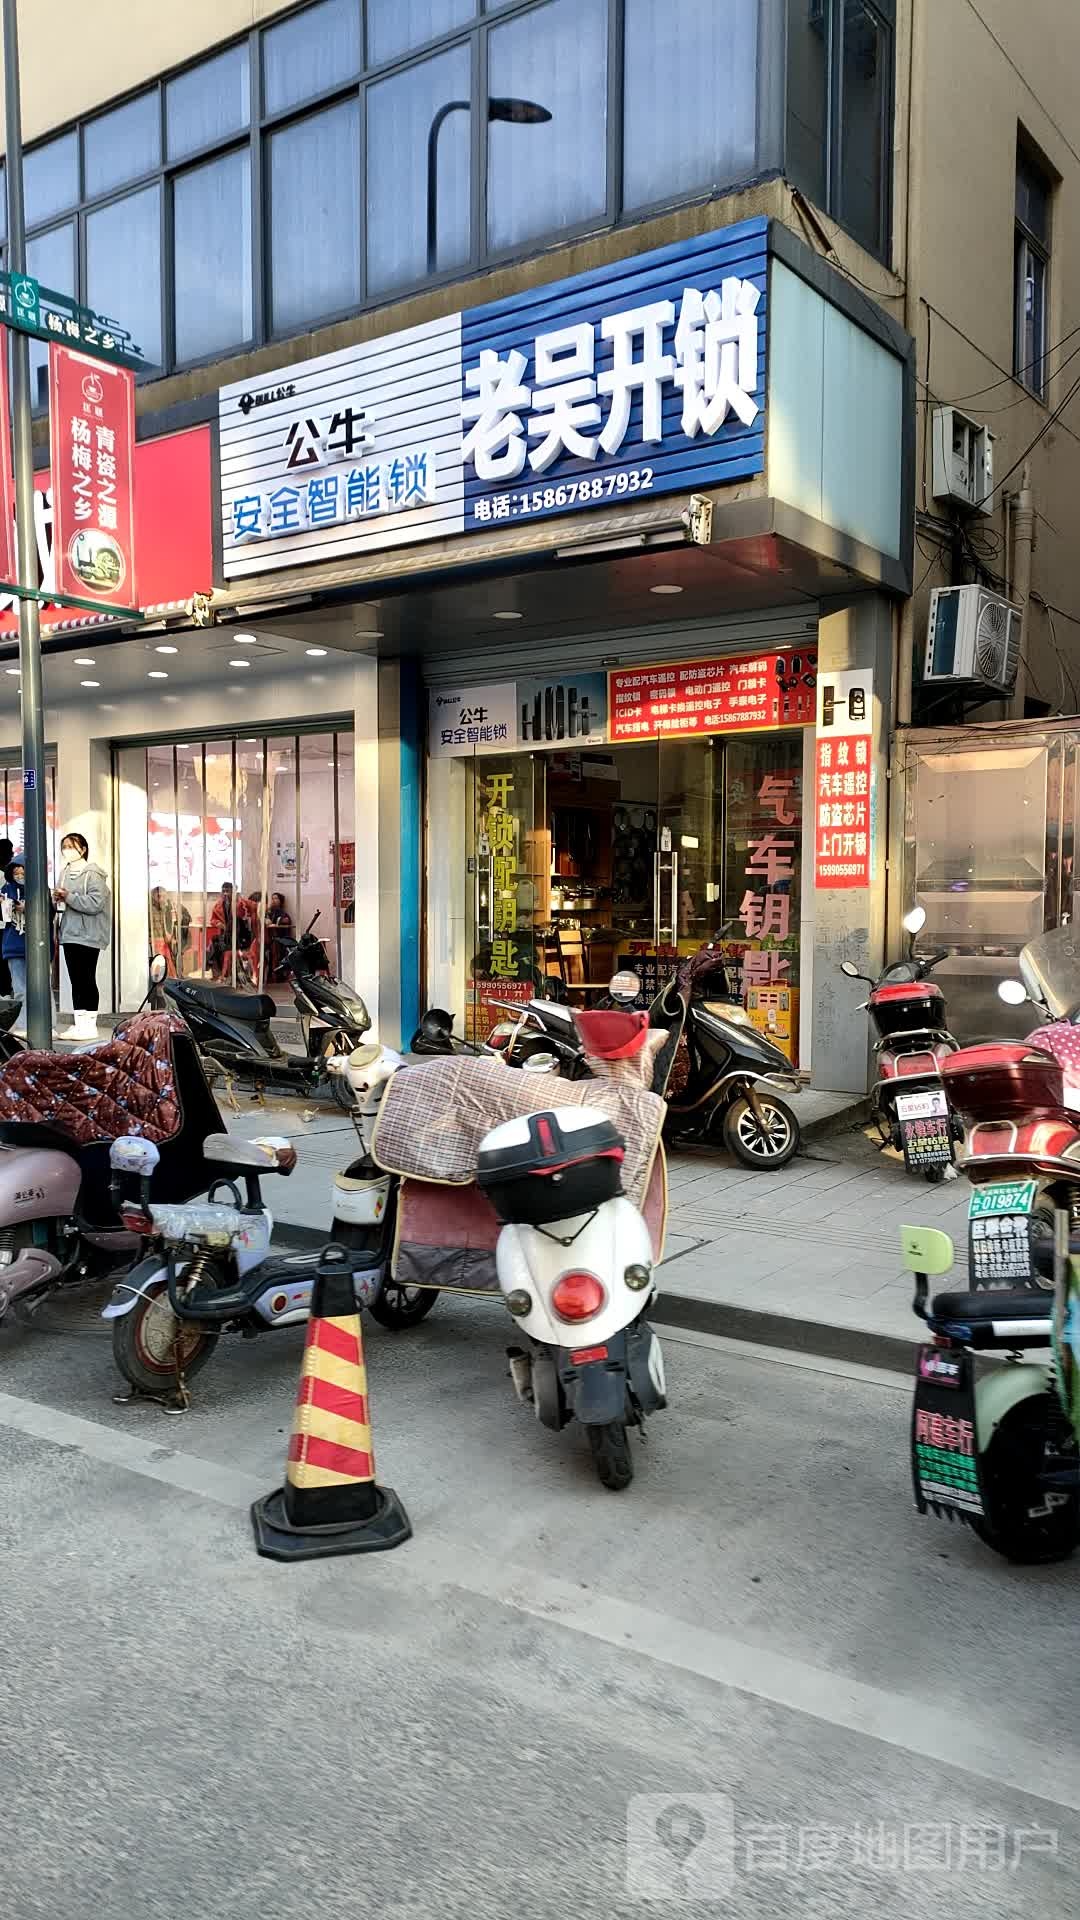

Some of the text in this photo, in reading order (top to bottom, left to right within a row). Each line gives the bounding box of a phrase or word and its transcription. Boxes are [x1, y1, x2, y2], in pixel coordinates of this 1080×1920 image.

[47, 312, 116, 349] 杨梅之乡
[461, 276, 762, 482] 老吴开锁
[286, 407, 368, 471] 公牛
[71, 415, 93, 521] 杨梅之乡
[95, 425, 117, 530] 青瓷之源
[232, 450, 430, 541] 安全智能锁
[473, 467, 655, 521] 电话:15867887932
[615, 672, 676, 688] 专业配汽车遥控
[680, 665, 725, 681] 配防盗芯片
[459, 706, 489, 726] 公牛
[440, 723, 508, 746] 安全智能锁
[819, 739, 868, 768] 指纹锁
[819, 770, 868, 798] 汽车遥控
[819, 801, 867, 828] 防盗芯片
[819, 832, 867, 857] 上门开锁
[485, 772, 520, 977] 开锁配钥匙
[982, 1191, 1029, 1210] 019874
